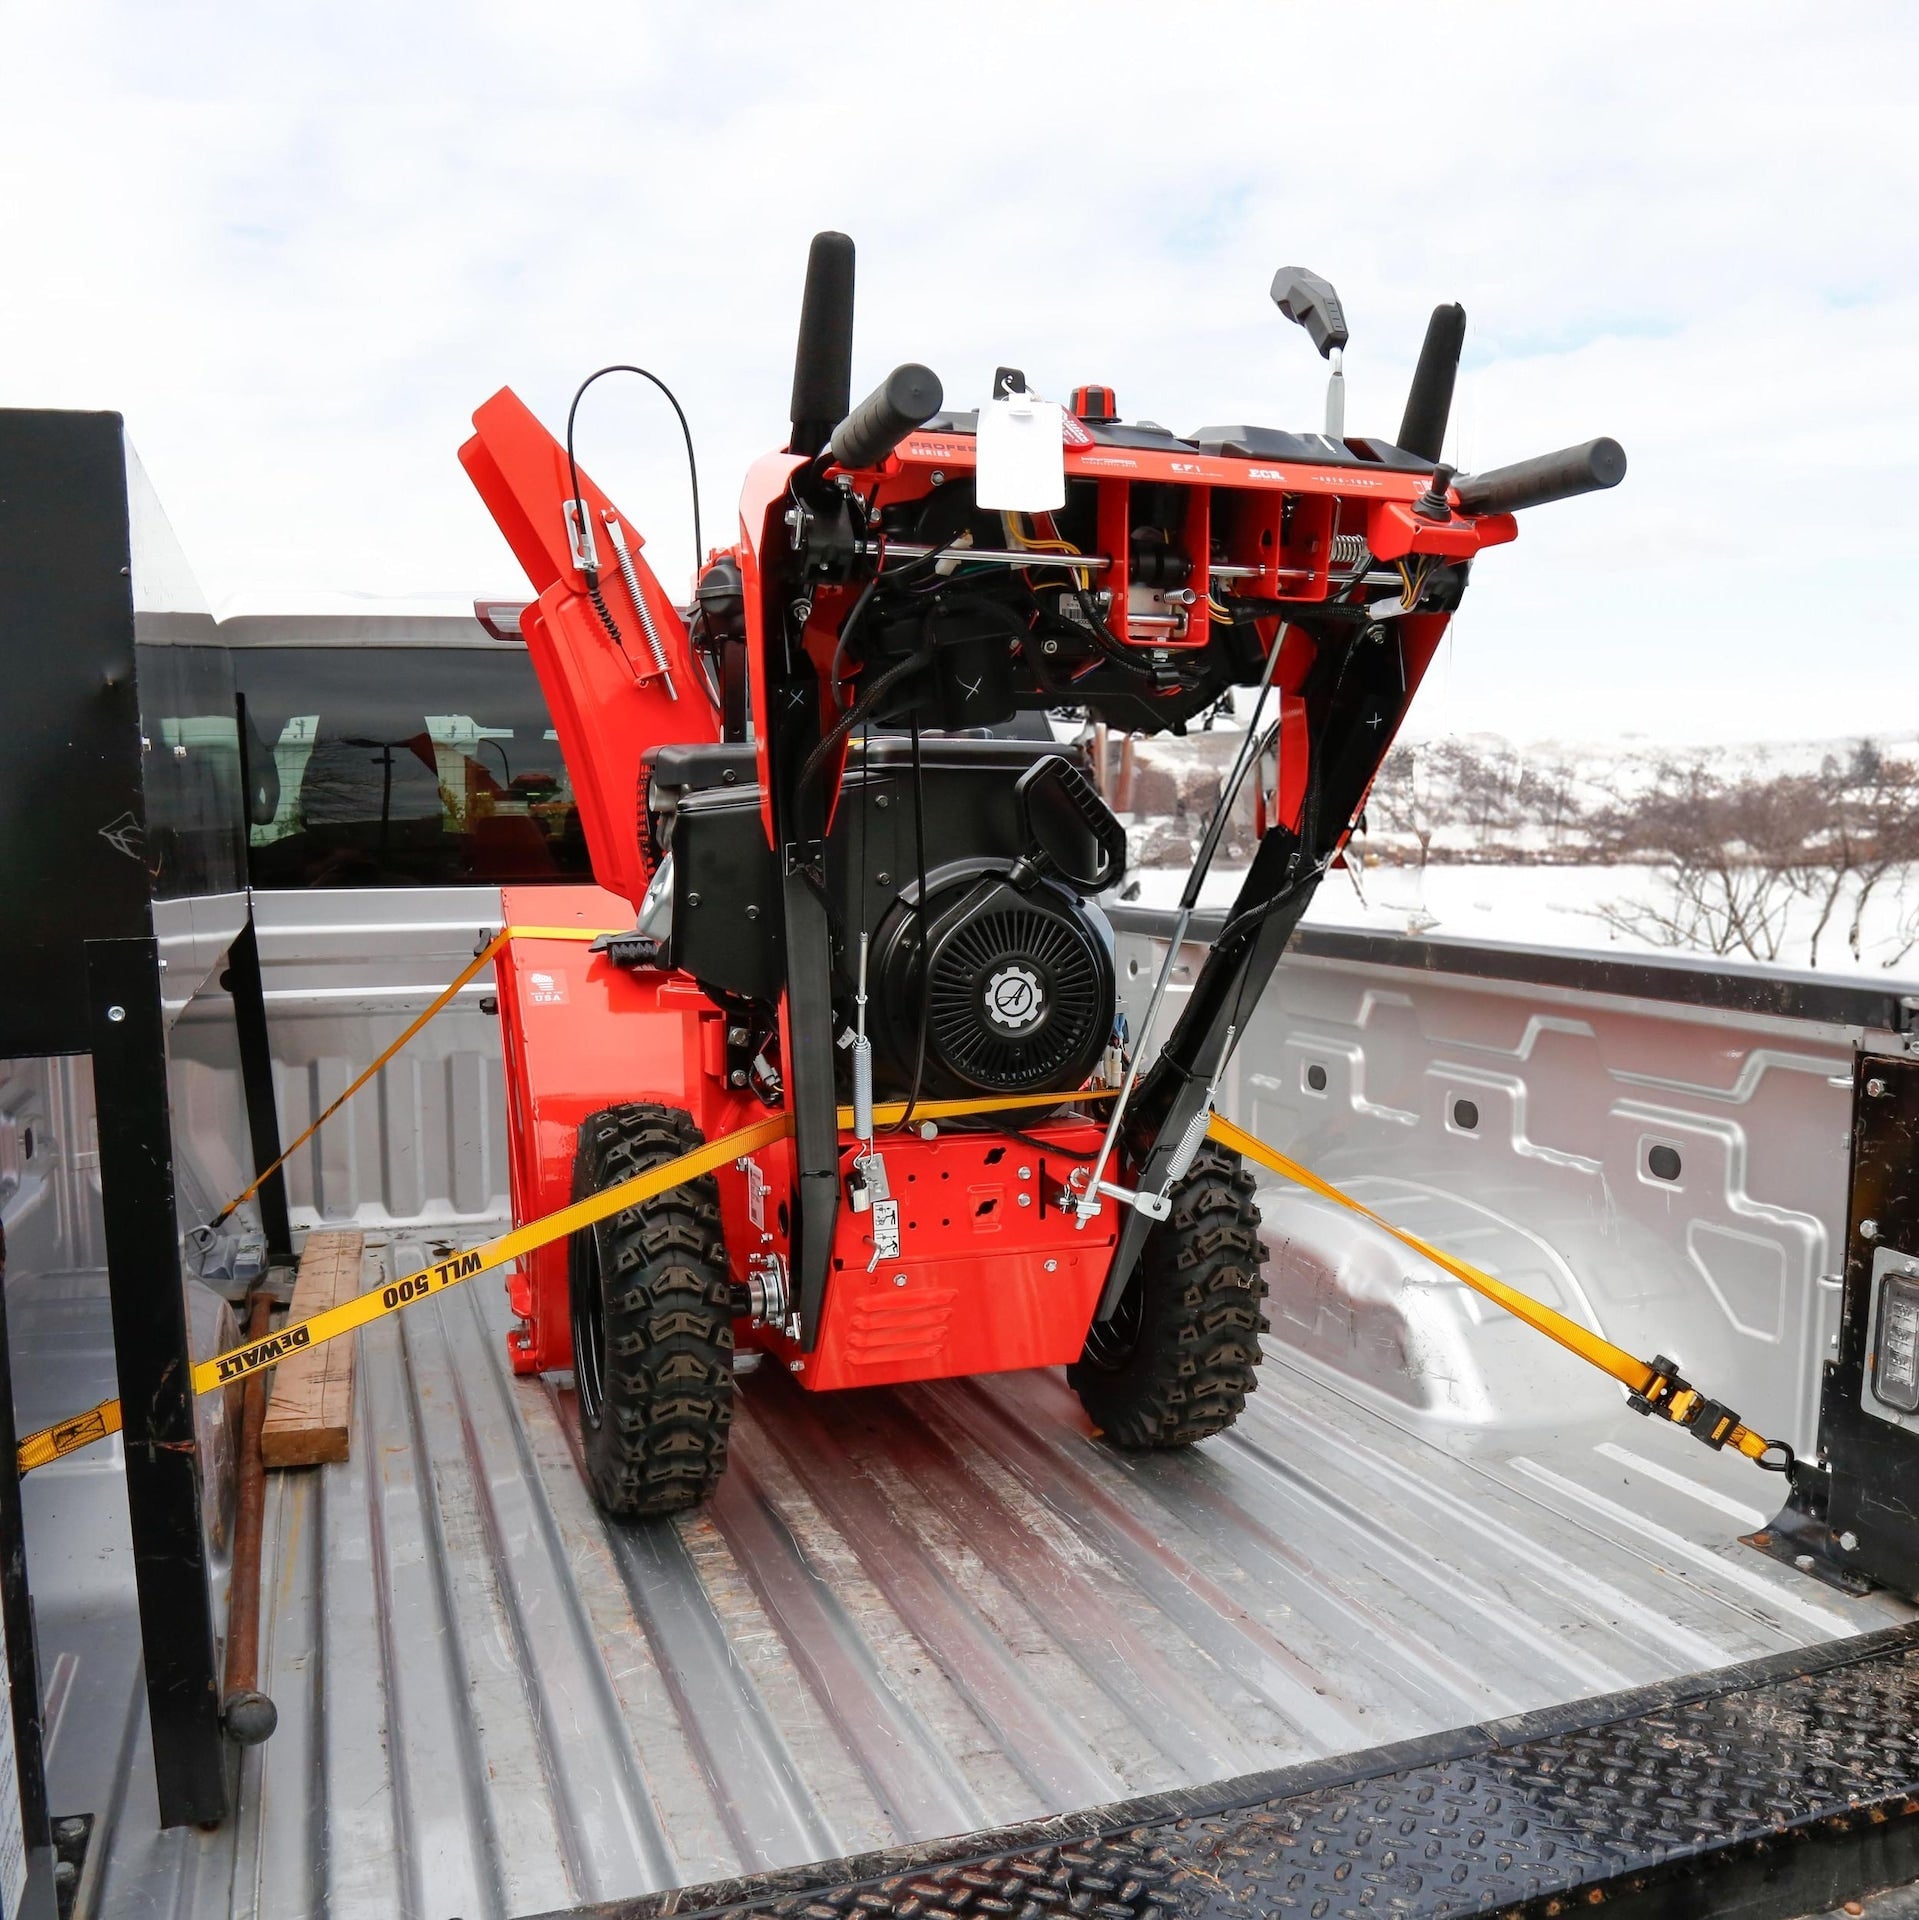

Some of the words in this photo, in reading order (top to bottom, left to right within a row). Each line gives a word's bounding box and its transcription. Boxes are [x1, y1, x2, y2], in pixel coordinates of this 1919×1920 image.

[911, 448, 952, 458] SERIES
[1248, 468, 1286, 480] ECR
[534, 994, 561, 1002] USA
[435, 1251, 482, 1285] WLL
[383, 1274, 429, 1309] 500
[216, 1325, 310, 1382] DEWALT
